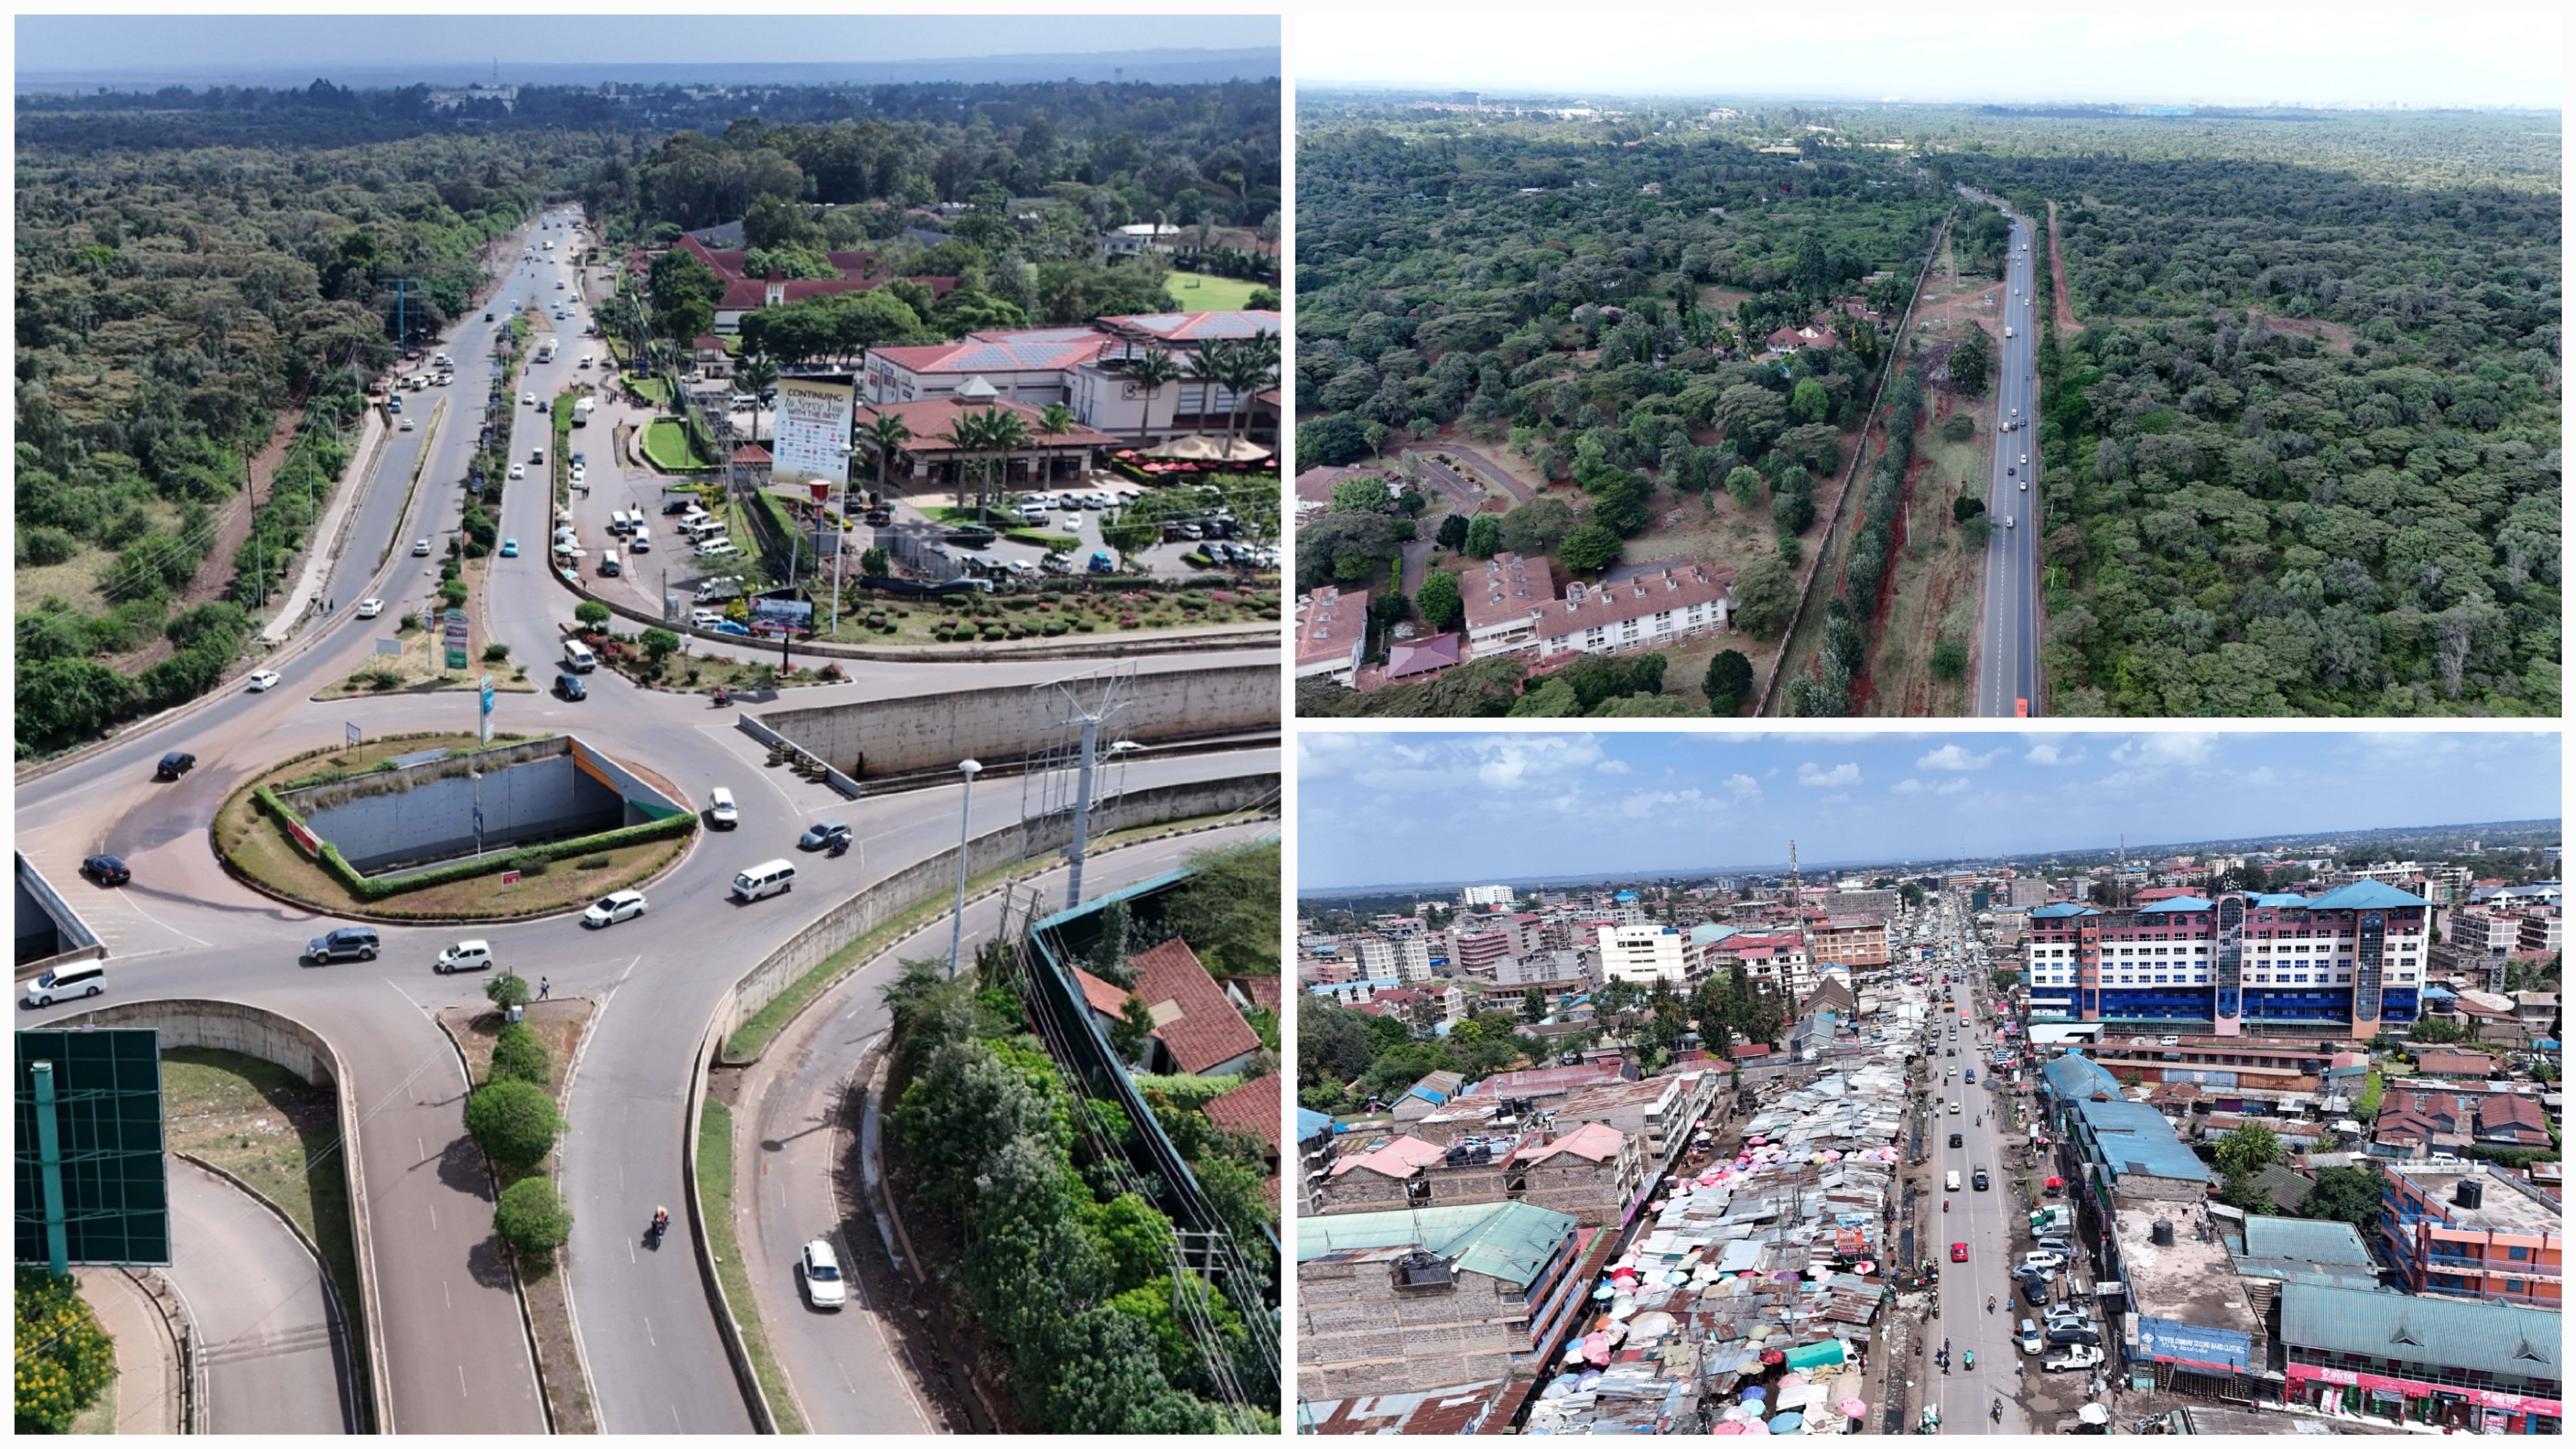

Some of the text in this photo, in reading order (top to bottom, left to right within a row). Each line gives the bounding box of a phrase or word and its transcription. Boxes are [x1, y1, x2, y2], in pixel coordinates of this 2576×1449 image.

[788, 388, 843, 402] CONTINUING
[797, 398, 824, 411] Serve
[827, 398, 845, 415] You
[787, 408, 806, 417] WITH
[808, 409, 821, 419] THE
[822, 411, 841, 421] BEST
[2158, 1336, 2245, 1354] SEVEN SUNDAY SECOND HAND CLOTHES
[2330, 1370, 2357, 1382] airtel
[2491, 1393, 2521, 1405] airtel
